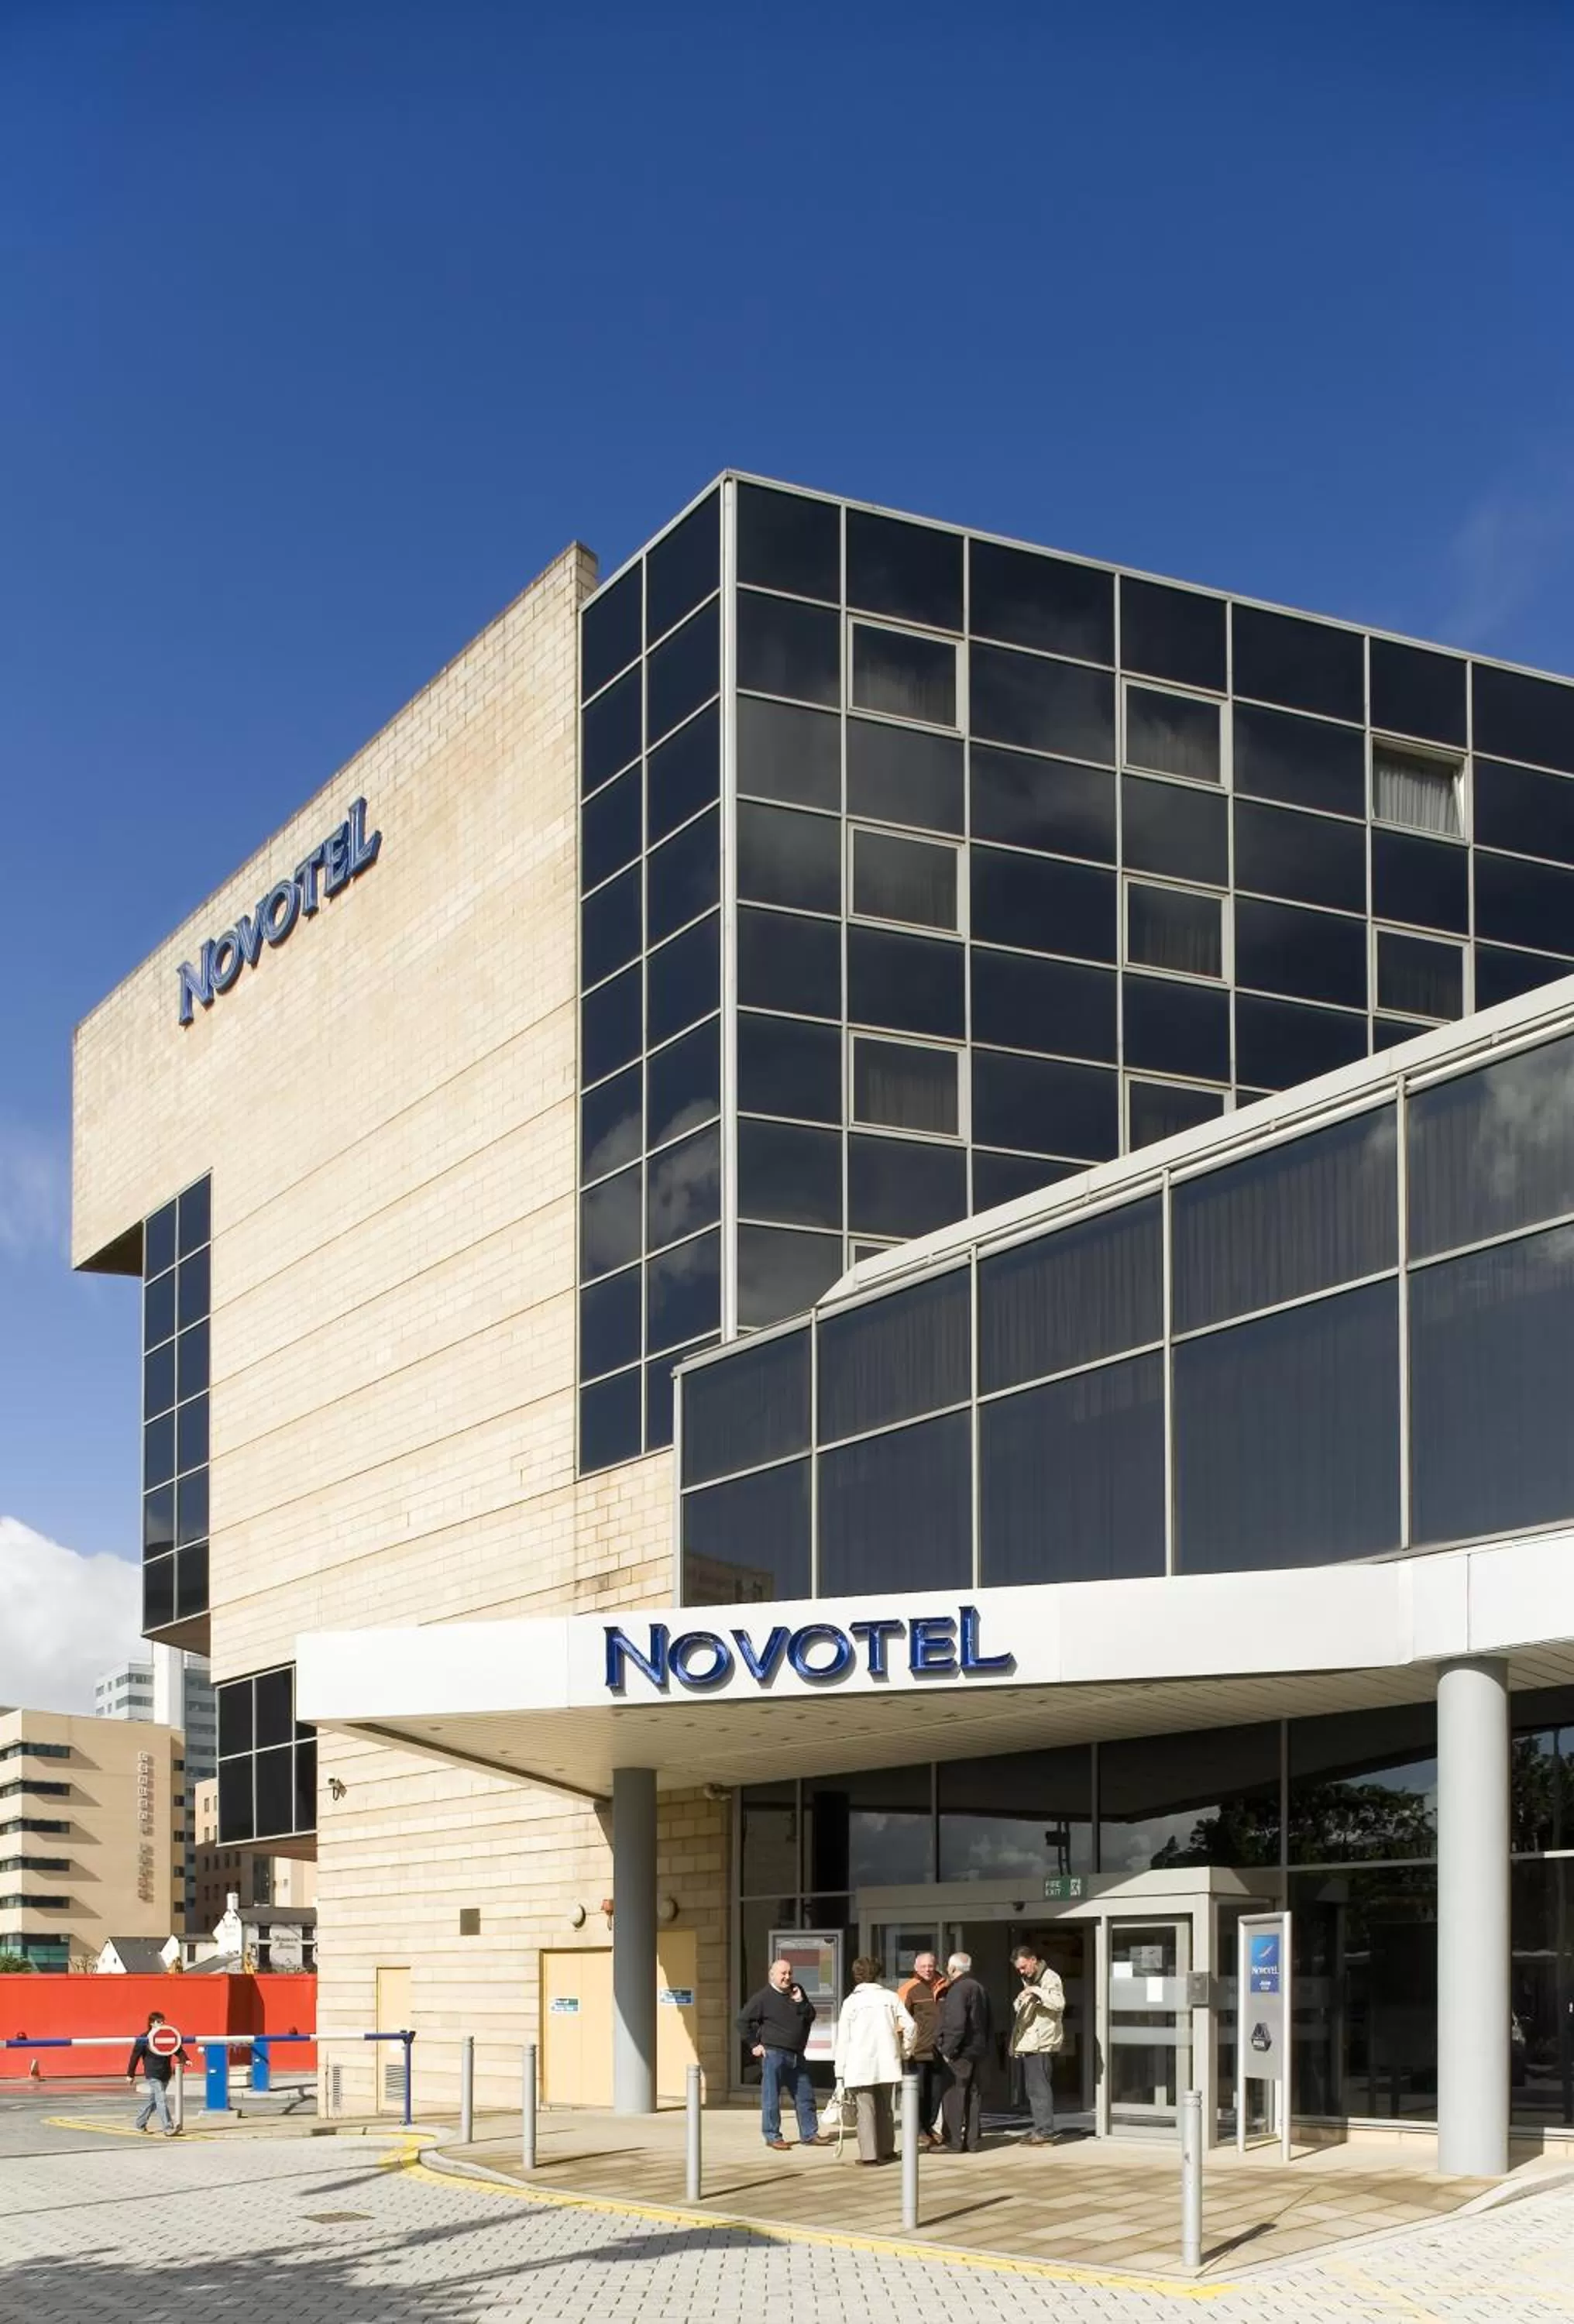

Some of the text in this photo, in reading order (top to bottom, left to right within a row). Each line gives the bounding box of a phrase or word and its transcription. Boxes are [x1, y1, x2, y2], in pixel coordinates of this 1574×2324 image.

[177, 796, 382, 1026] NOVOTEL
[603, 1605, 1016, 1689] NOVOTEL
[1045, 1888, 1061, 1896] EXIT
[1251, 1966, 1280, 1975] NOVOTEL
